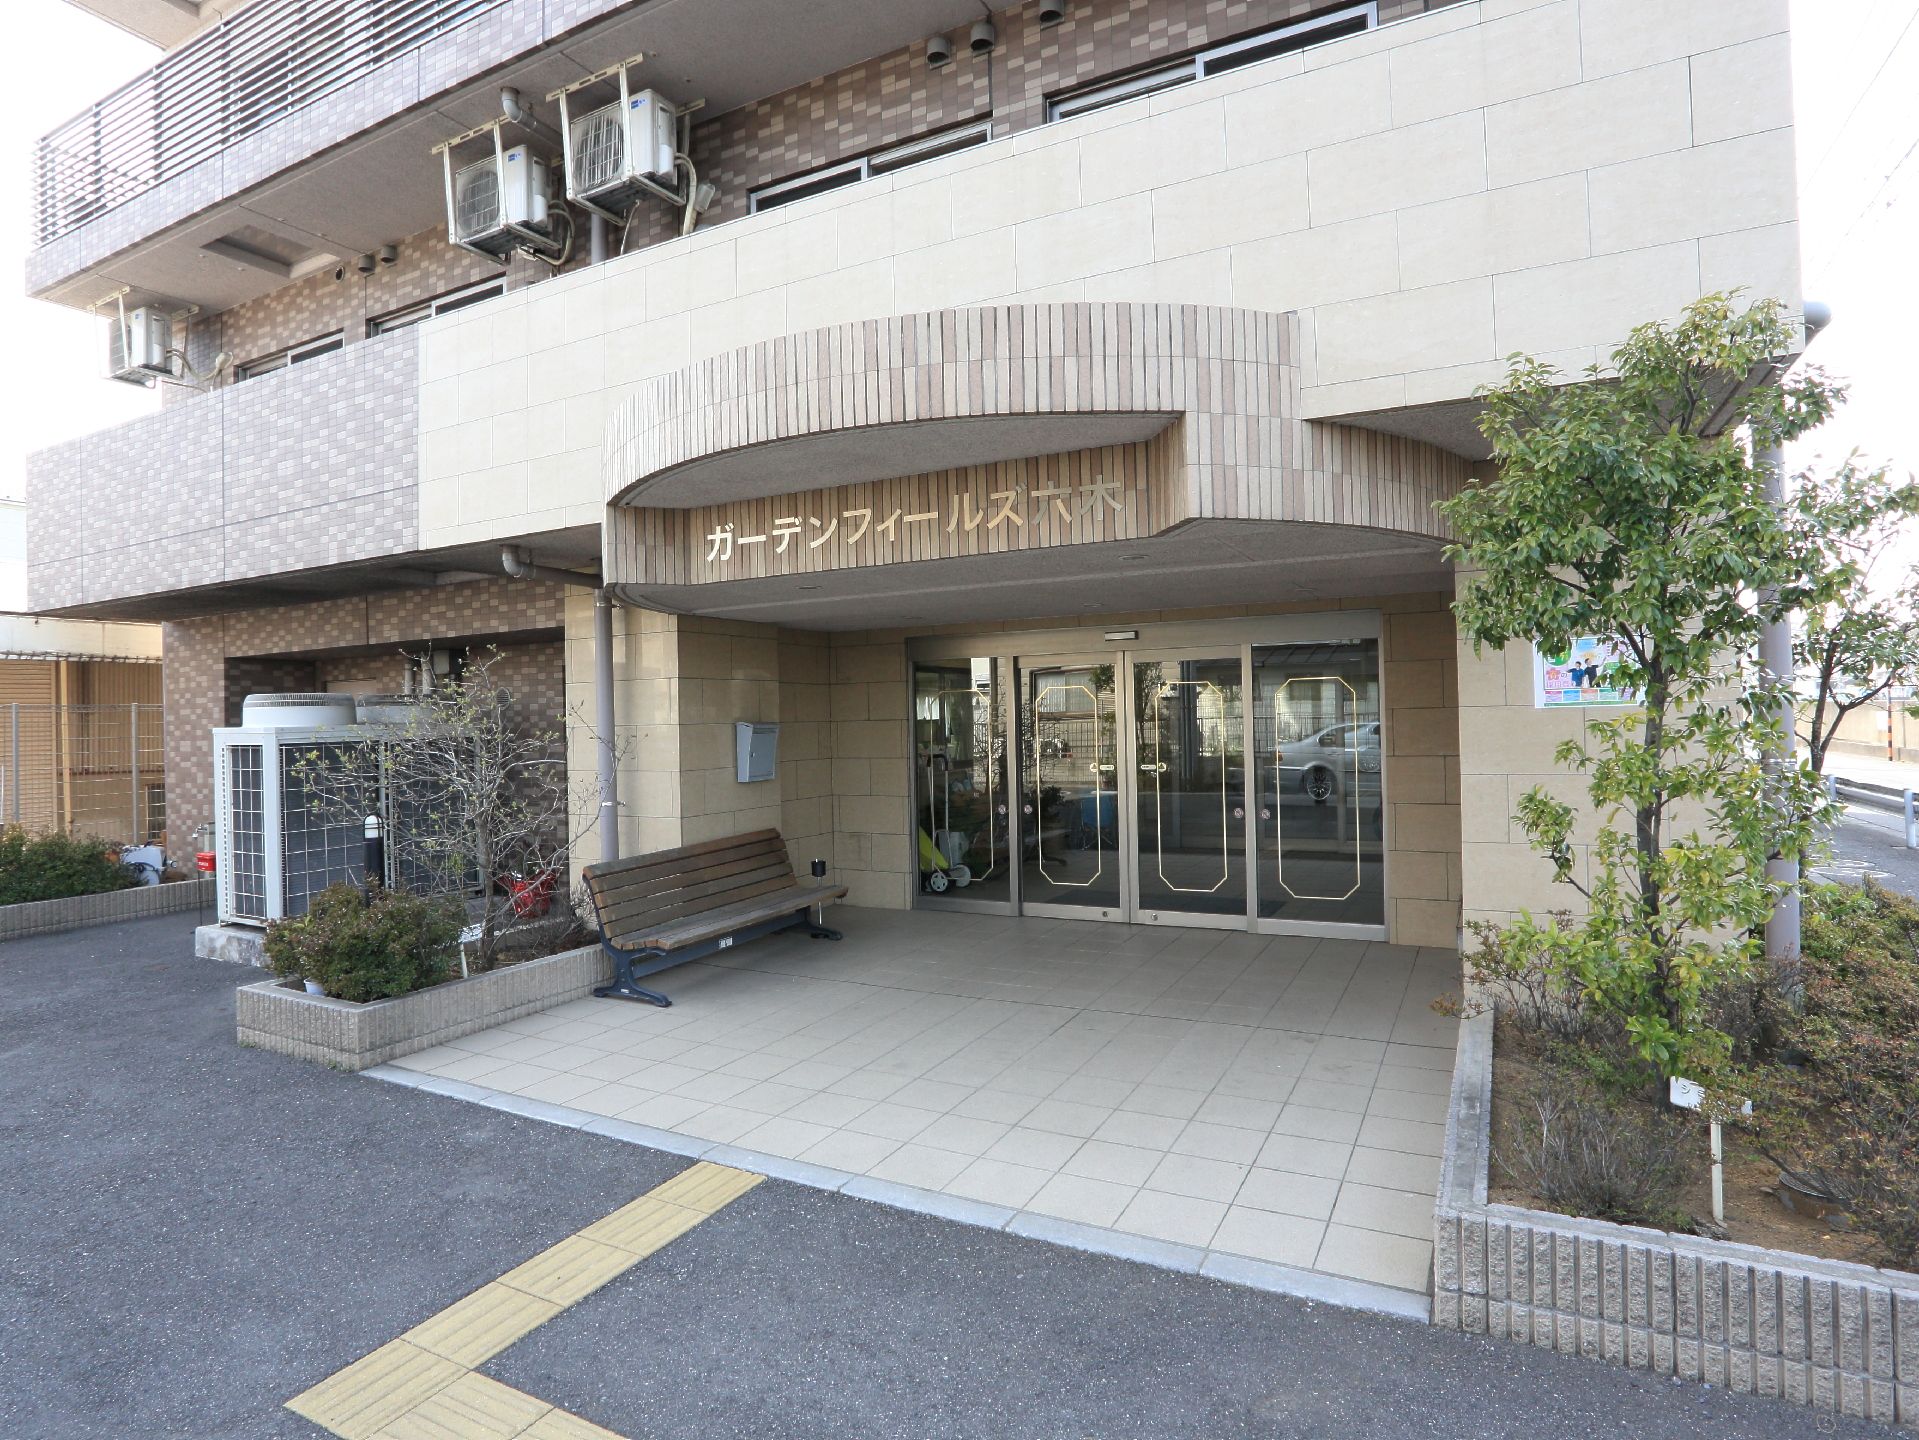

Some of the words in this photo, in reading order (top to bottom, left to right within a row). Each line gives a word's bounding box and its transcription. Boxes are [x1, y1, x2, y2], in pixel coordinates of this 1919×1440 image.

[707, 475, 1124, 562] ガーデンフィールズ六木
